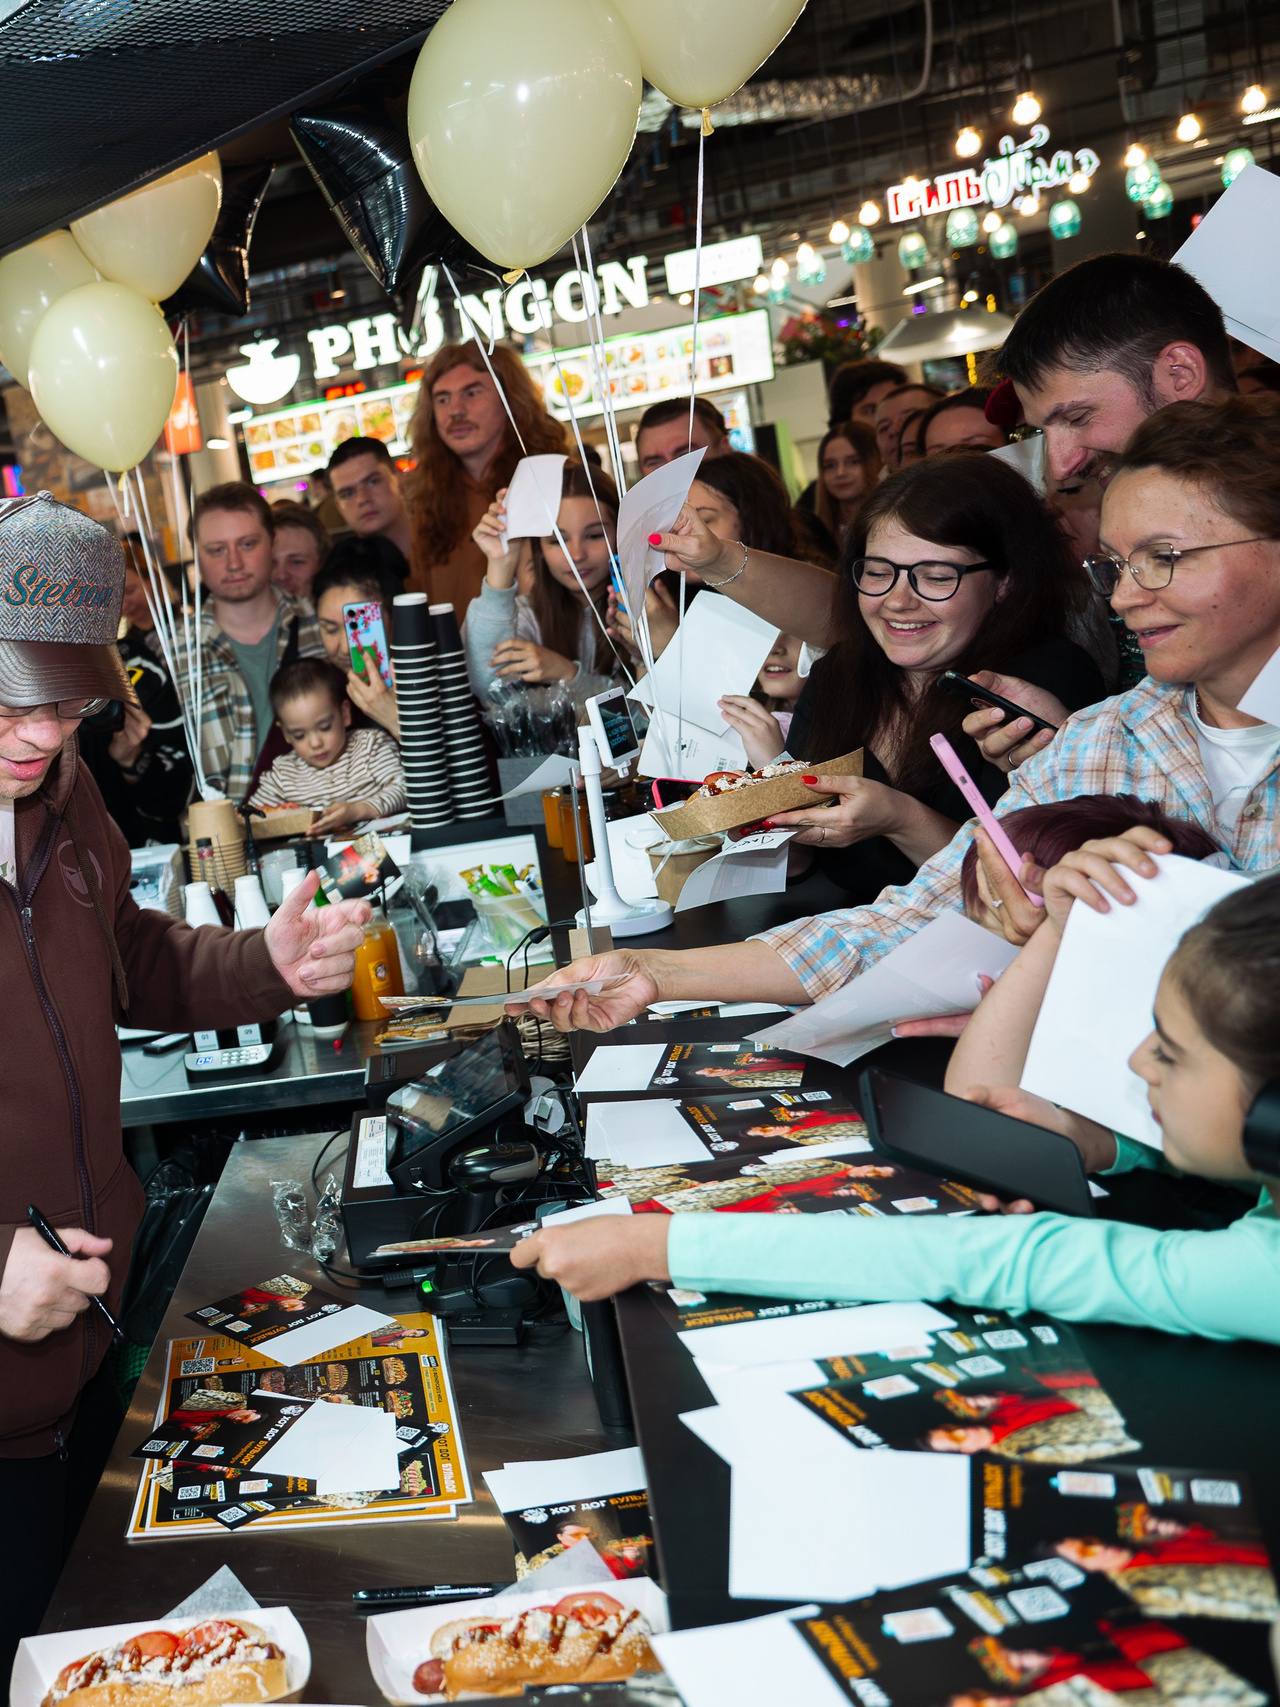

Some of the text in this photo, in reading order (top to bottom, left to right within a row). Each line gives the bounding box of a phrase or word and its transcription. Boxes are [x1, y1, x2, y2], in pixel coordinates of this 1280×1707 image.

[454, 255, 649, 345] NGON
[3, 563, 113, 610] Stetson
[250, 1325, 287, 1344] БУЛЬДОГ
[287, 1318, 304, 1328] ДОГ
[239, 1415, 291, 1467] ХОТ ДОГ БУЛЬДОГ
[438, 1436, 457, 1493] ХОТ ДОГ БУЛЬДОГ
[550, 1504, 577, 1515] ХОТ
[581, 1500, 607, 1511] ДОГ
[609, 1493, 648, 1506] БУЛЬ
